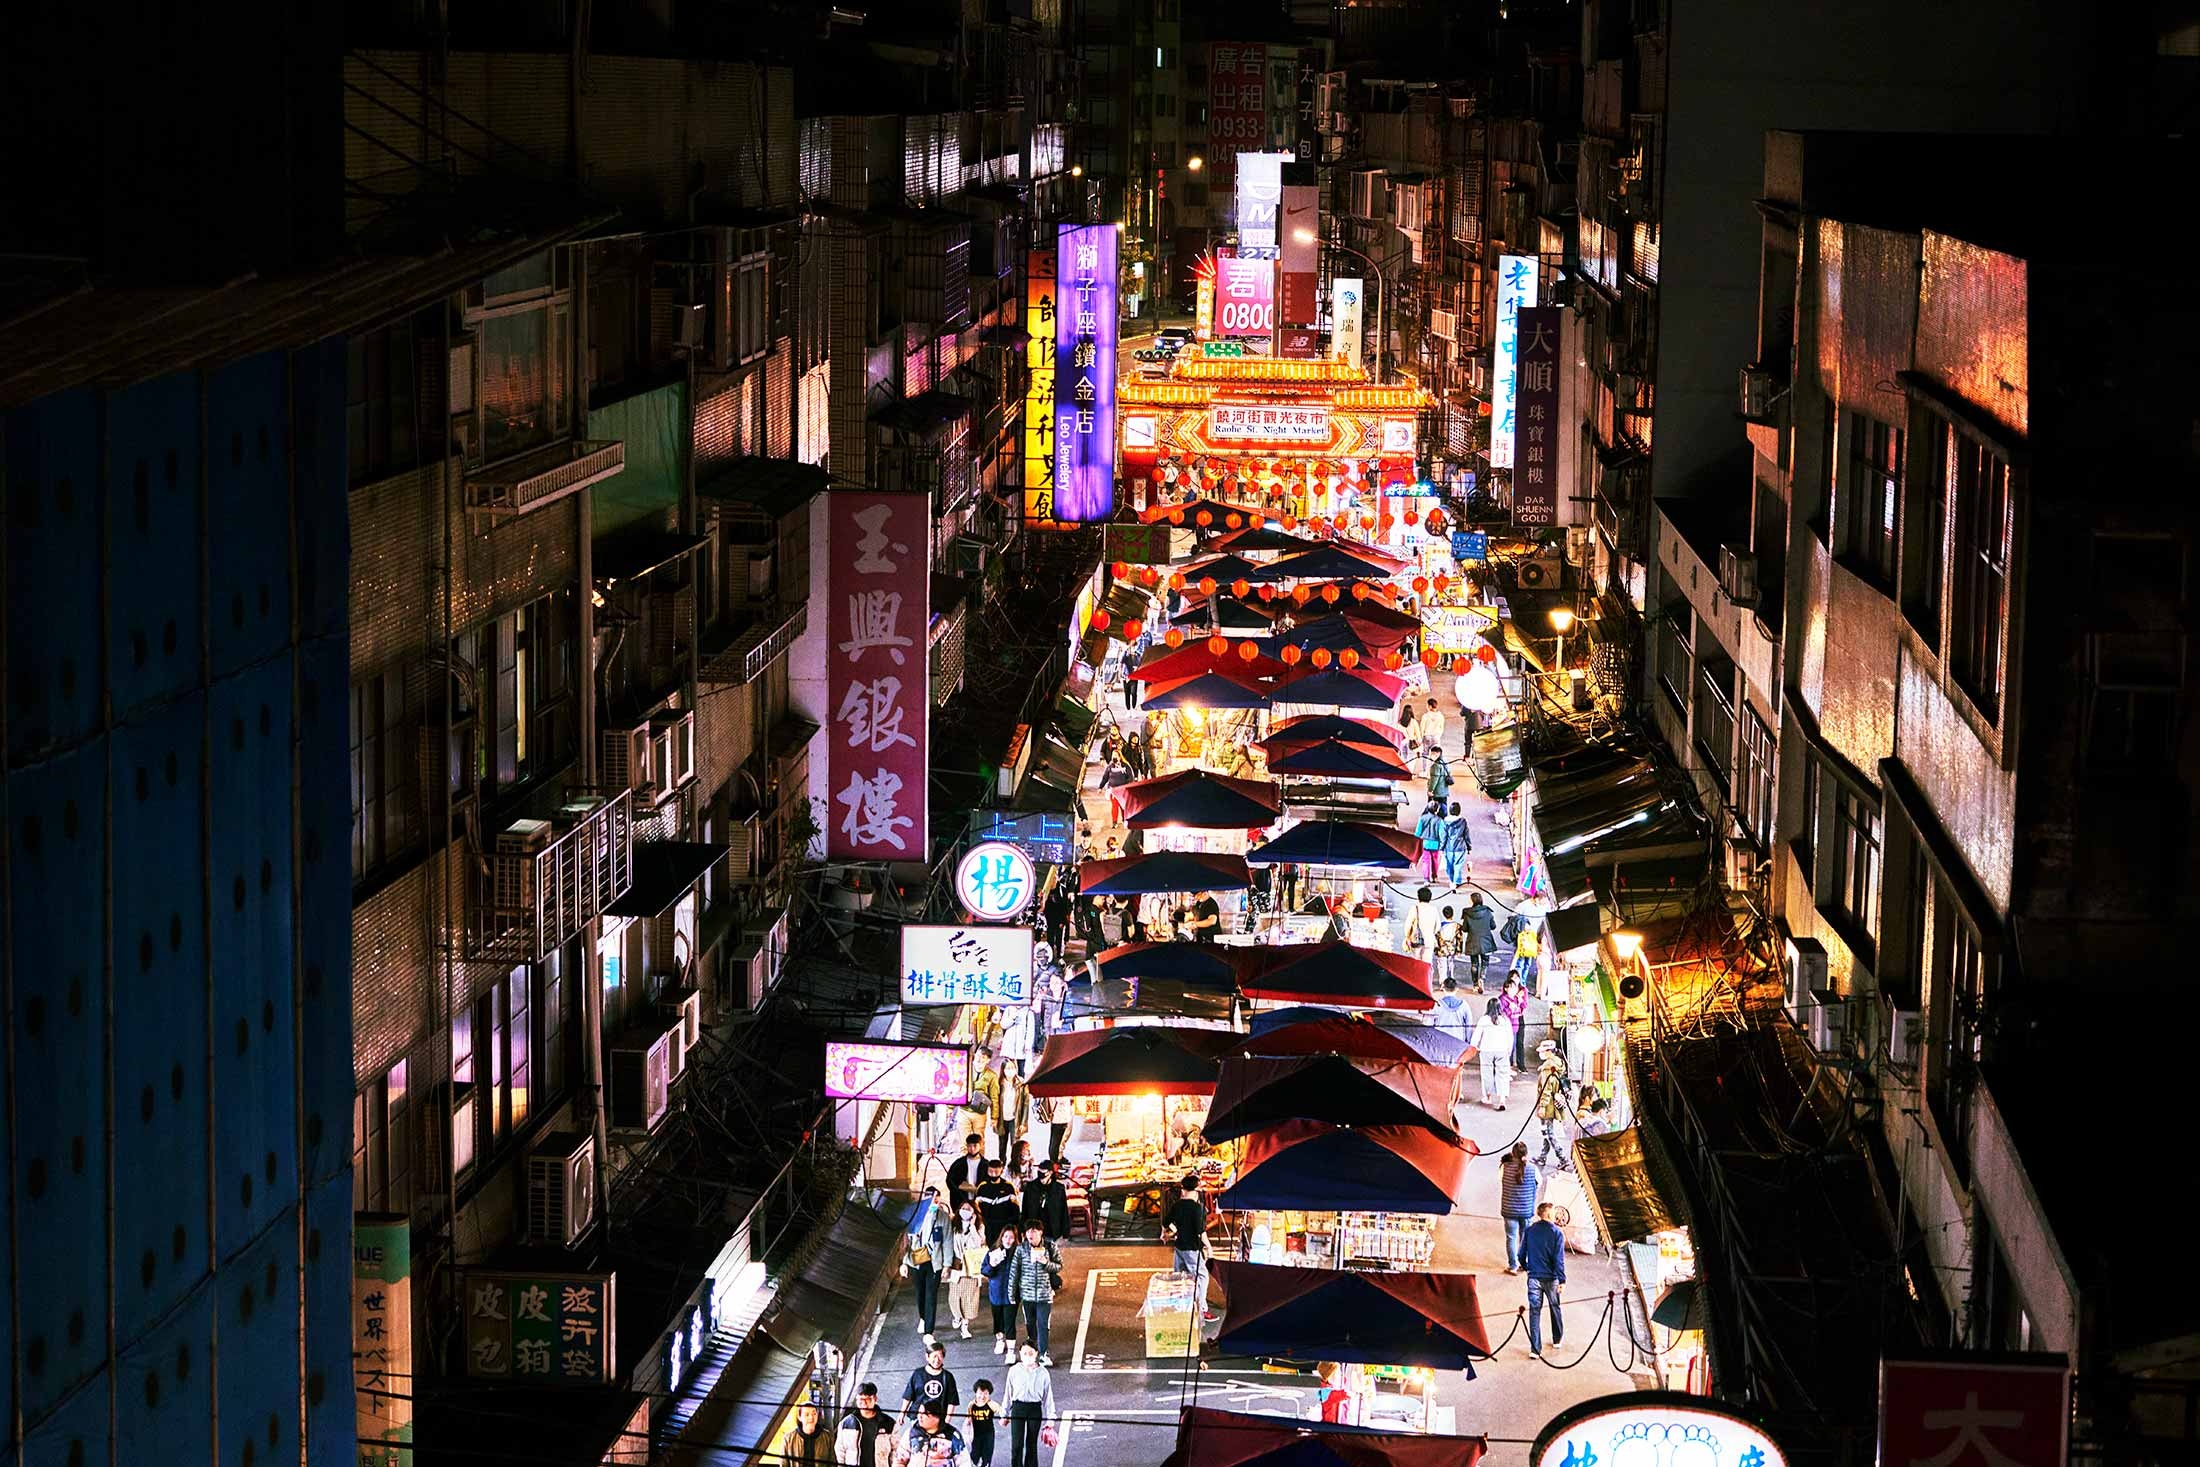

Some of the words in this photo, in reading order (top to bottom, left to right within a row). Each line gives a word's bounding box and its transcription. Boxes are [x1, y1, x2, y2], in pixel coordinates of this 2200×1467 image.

[1213, 47, 1264, 76] 廣告
[1213, 81, 1264, 112] 出租
[1073, 244, 1098, 435] 獅子座鑽金店
[1523, 322, 1555, 393] 大順
[1060, 416, 1073, 438] Leo
[1215, 424, 1242, 434] Raohe
[1247, 425, 1258, 434] St.
[1263, 426, 1287, 435] Night
[1292, 426, 1325, 435] Market
[1216, 410, 1324, 425] 饒河街觀光夜市
[1527, 405, 1544, 484] 珠寶銀樓
[1056, 441, 1072, 491] Jewelery
[1516, 505, 1554, 514] SHUENN
[1520, 514, 1549, 523] GOLD
[1525, 496, 1545, 504] DAR
[1444, 613, 1490, 628] Amigo
[836, 503, 917, 851] 玉興銀樓
[970, 854, 1022, 911] 楊
[907, 969, 1024, 1001] 排骨酥麵
[472, 1283, 508, 1373] 皮包
[515, 1285, 552, 1374] 皮箱
[561, 1286, 598, 1377] 旅行袋
[362, 1291, 388, 1415] 世界ベスト
